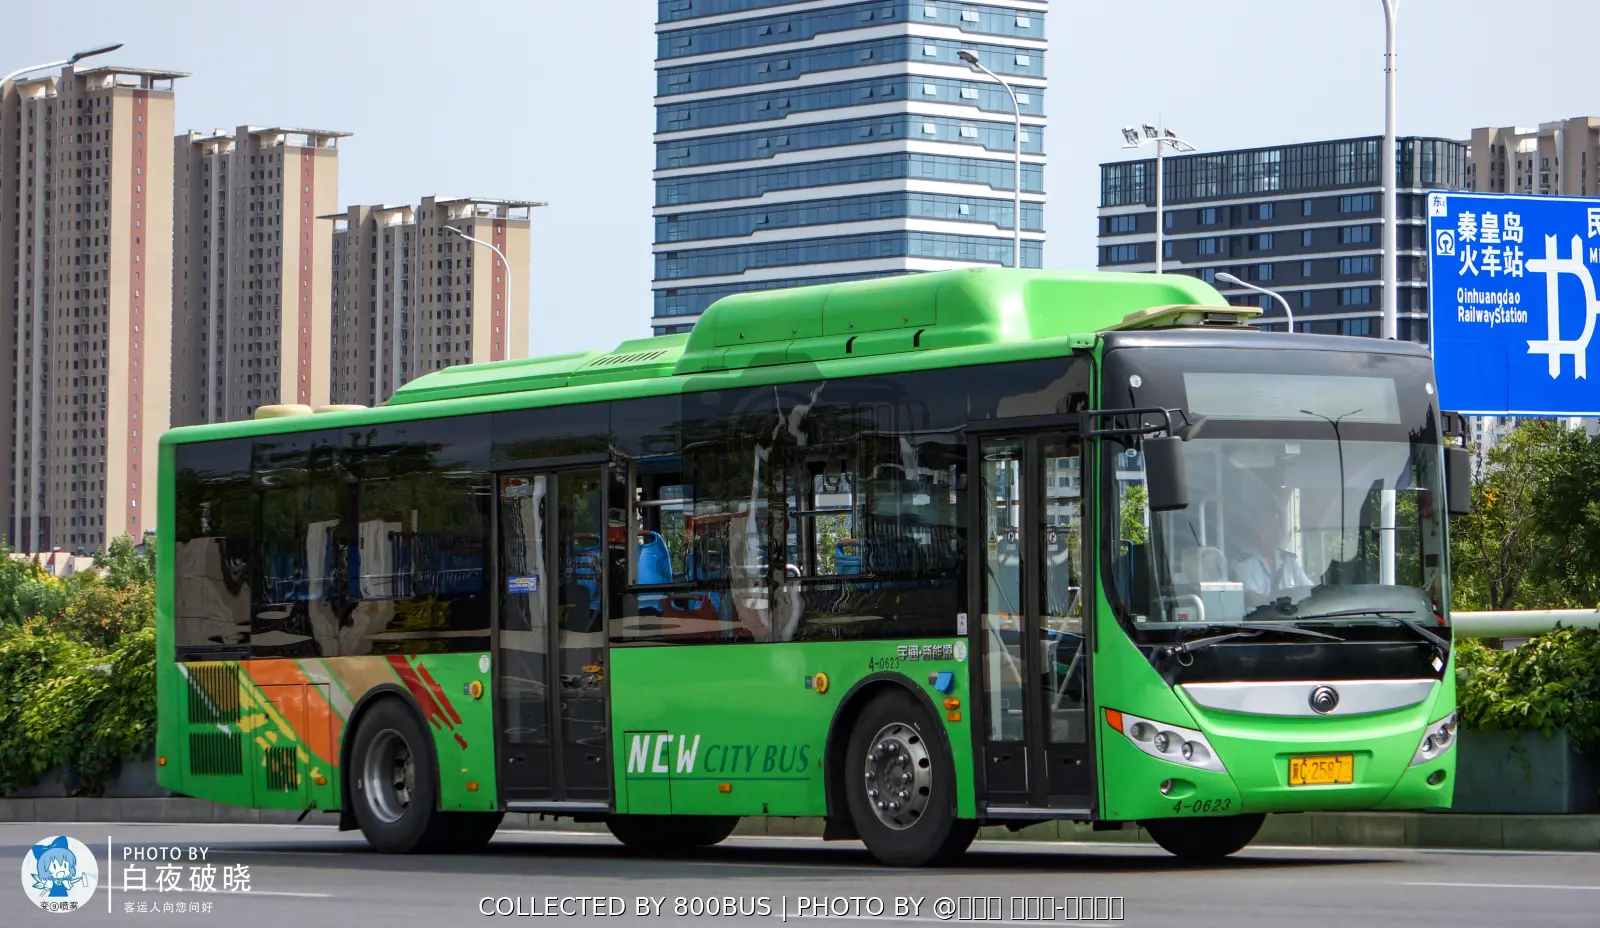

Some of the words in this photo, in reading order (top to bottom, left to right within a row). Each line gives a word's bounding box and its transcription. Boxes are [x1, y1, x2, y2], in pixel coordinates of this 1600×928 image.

[1457, 210, 1524, 244] 秦皇岛
[1458, 245, 1524, 278] 火车站
[1457, 287, 1521, 308] Qinhuangdao
[868, 656, 900, 672] 4-0623
[628, 734, 700, 774] NEW
[704, 745, 760, 773] CITY
[763, 744, 811, 773] BUS
[1173, 798, 1232, 814] 4-0623
